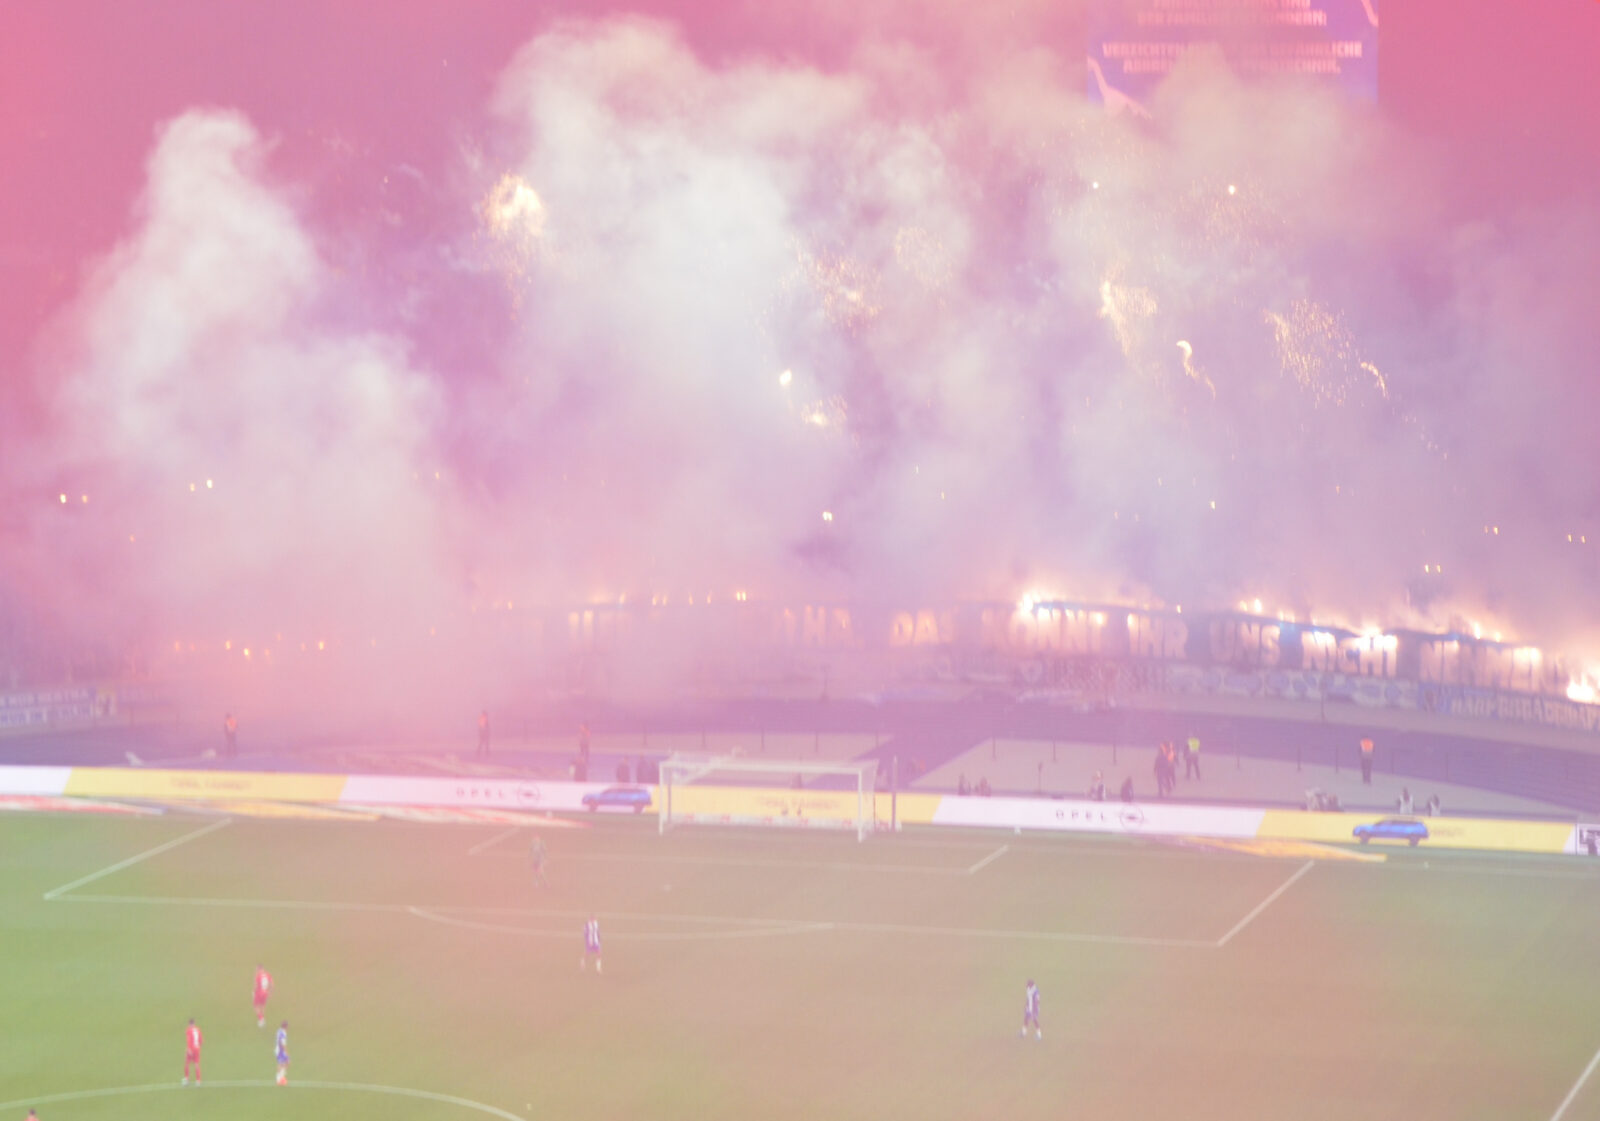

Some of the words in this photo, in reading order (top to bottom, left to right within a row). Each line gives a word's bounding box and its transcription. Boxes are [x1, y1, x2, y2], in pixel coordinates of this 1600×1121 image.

[1126, 612, 1189, 660] IHR
[1209, 619, 1281, 666] UNS
[1301, 630, 1399, 679] NICHT
[455, 786, 506, 800] OPEL
[1055, 808, 1106, 821] OPEL
